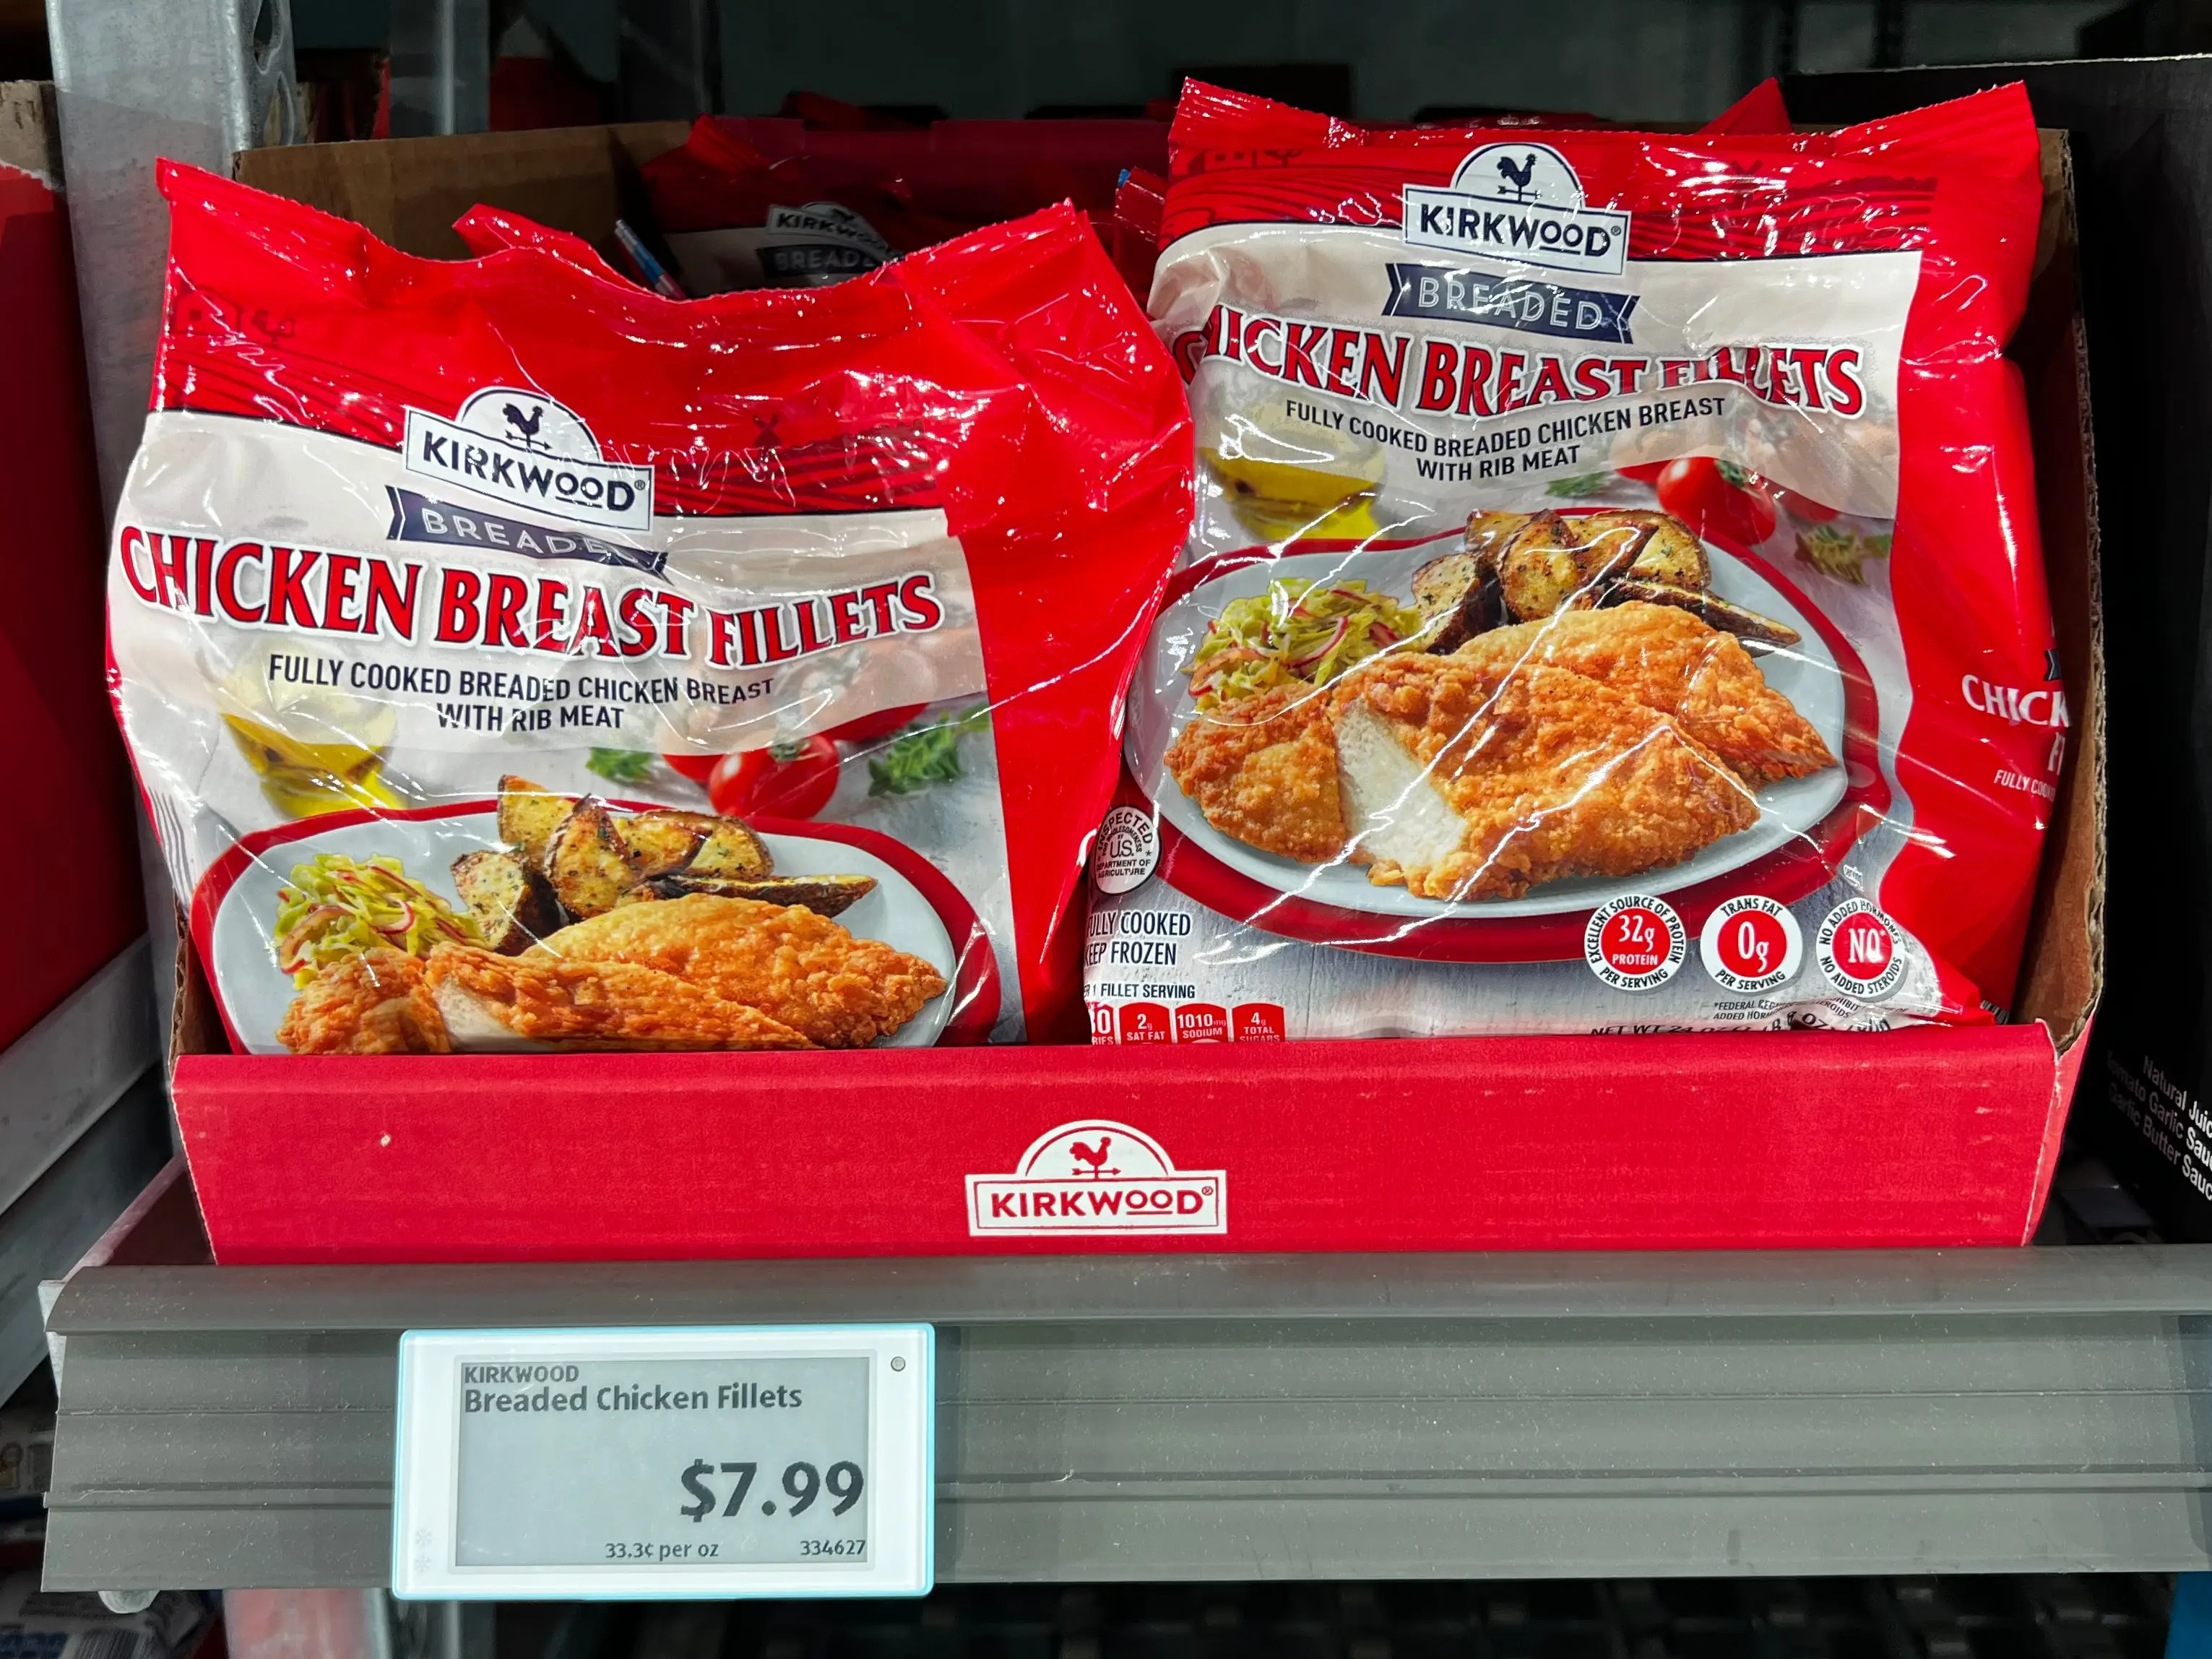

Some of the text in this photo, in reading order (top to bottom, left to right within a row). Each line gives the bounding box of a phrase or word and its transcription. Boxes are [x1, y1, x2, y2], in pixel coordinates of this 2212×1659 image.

[1418, 277, 1603, 329] BREADED
[1416, 341, 1649, 417] BREAST
[1662, 347, 1863, 415] FILLETS
[1286, 397, 1726, 459] FULLY COOKED BREADED CHICKEN BREAST
[1417, 444, 1581, 482] WITH RIB MEAT
[120, 526, 940, 666] CHICKEN BREAST FILLETS
[269, 654, 774, 704] FULLY COOKED BREADED CHICKEN BREAST
[436, 702, 624, 731] WITH RIB MEAT
[1993, 769, 2030, 791] FULLY
[1110, 839, 1134, 858] U.S.
[1720, 897, 1783, 918] TRANS FAT
[1120, 911, 1191, 936] COOKED
[1586, 896, 1685, 965] EXCELLENT SOURCE OF PROTEIN
[1618, 914, 1655, 952] 32g
[1819, 927, 1833, 945] NO
[1828, 901, 1858, 928] ADDED
[1110, 941, 1177, 965] FROZEN
[1612, 953, 1659, 965] PROTEIN
[1737, 921, 1769, 973] 0g
[1599, 966, 1669, 988] PER SERVING
[1715, 969, 1786, 990] PER SERVING
[1820, 955, 1902, 994] NO ADDED STEROIDS
[1101, 983, 1139, 997] FILLET
[1143, 984, 1196, 999] SERVING
[1127, 1031, 1165, 1041] SAT FAT
[1183, 1027, 1222, 1039] SODIUM
[1243, 1026, 1275, 1035] TOTAL
[2143, 1055, 2187, 1111] Natural
[2148, 1091, 2184, 1139] Garlic
[2142, 1113, 2181, 1165] Butter
[464, 1365, 579, 1384] KIRKWOOD
[465, 1382, 803, 1413] Breaded Chicken Fillets
[681, 1459, 864, 1523] $7.99
[605, 1541, 720, 1564] 33.3¢ per oz
[800, 1539, 866, 1557] 334627
